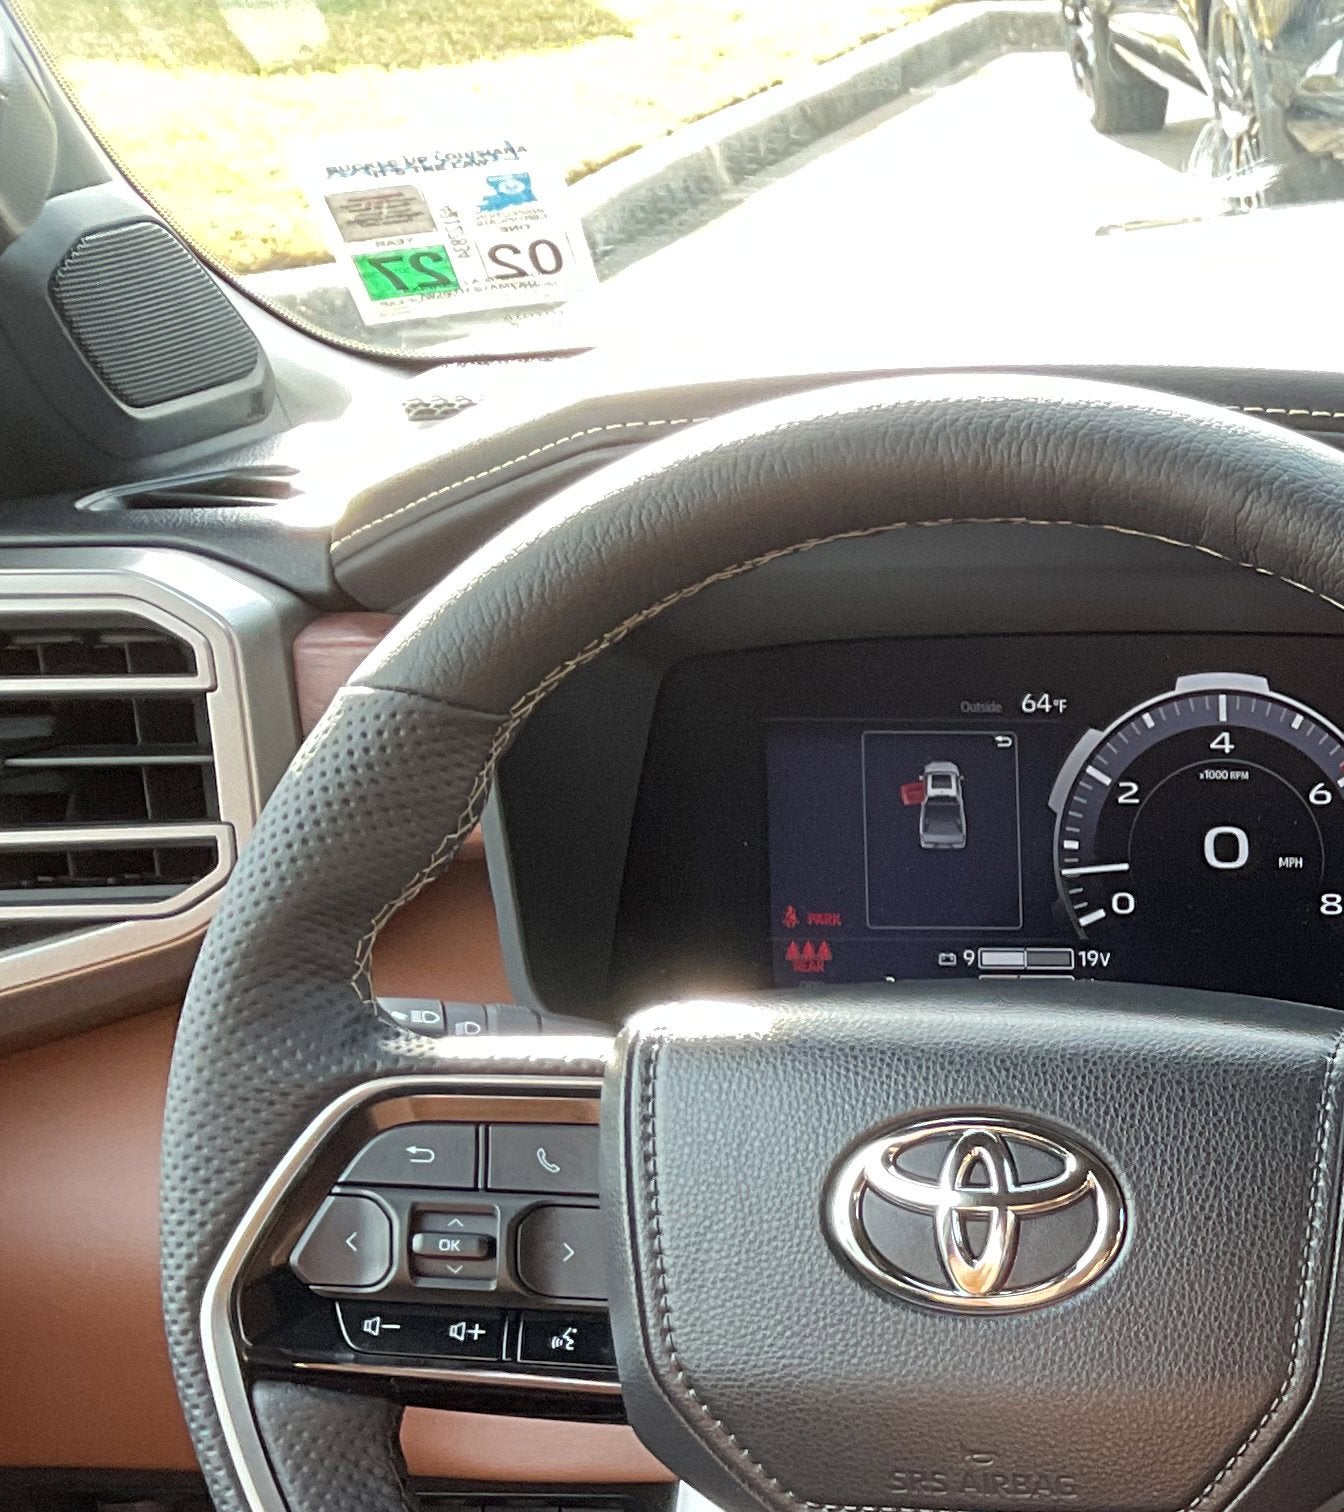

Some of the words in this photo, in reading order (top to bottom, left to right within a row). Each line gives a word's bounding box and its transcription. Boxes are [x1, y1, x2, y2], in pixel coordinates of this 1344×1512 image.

[1209, 731, 1235, 754] 4
[1116, 782, 1141, 804] 2
[1308, 782, 1333, 805] 6
[1203, 825, 1250, 870] 0
[1278, 856, 1304, 869] MPH
[1111, 892, 1136, 915] 0
[1319, 892, 1344, 916] 8
[962, 950, 975, 966] 9
[1077, 949, 1111, 968] 19V
[438, 1238, 461, 1252] OK
[890, 1471, 949, 1496] SRS
[959, 1472, 1079, 1500] AIRBAG
